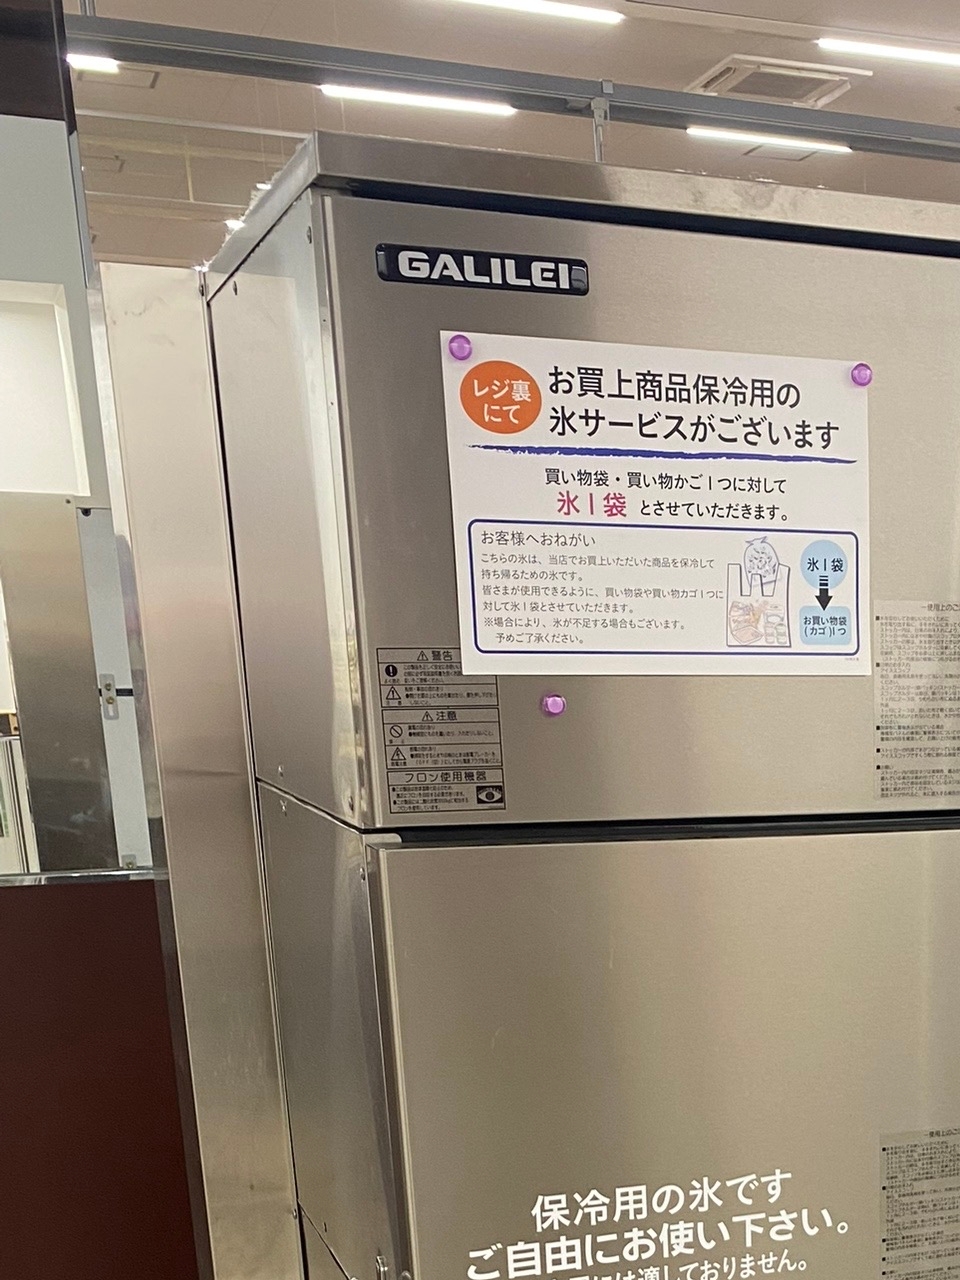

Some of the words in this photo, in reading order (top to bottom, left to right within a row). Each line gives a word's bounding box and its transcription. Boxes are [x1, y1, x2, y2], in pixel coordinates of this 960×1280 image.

[397, 251, 570, 290] GALILEI
[472, 377, 532, 403] レジ裏
[547, 364, 801, 410] お買上商品保冷用の
[483, 403, 521, 425] にて
[548, 405, 840, 450] 氷サービスがございます
[544, 466, 788, 496] 買い物袋・買い物かご1つに対して
[556, 490, 627, 519] 氷1袋
[639, 500, 789, 523] とさせていただきます。
[480, 531, 596, 548] お客様へおねがい
[480, 553, 715, 569] こちらの氷は、当店でお買上いただいた商品を保冷して
[807, 557, 844, 573] 氷1袋
[481, 569, 583, 582] 持ち帰るための氷です。
[482, 584, 725, 600] 皆さまが使用できるように、買い物袋や買い物カゴ1つに
[483, 600, 634, 614] 対して氷1袋とさせていただきます。
[483, 617, 685, 631] ※場合により、氷が不足する場合もございます。
[803, 615, 847, 626] お買い物袋
[496, 632, 584, 645] 予めご了承ください。
[431, 650, 453, 661] 警告
[436, 710, 458, 721] 注意
[404, 771, 487, 784] フロン使用機器
[530, 1168, 793, 1233] 保冷用の氷です
